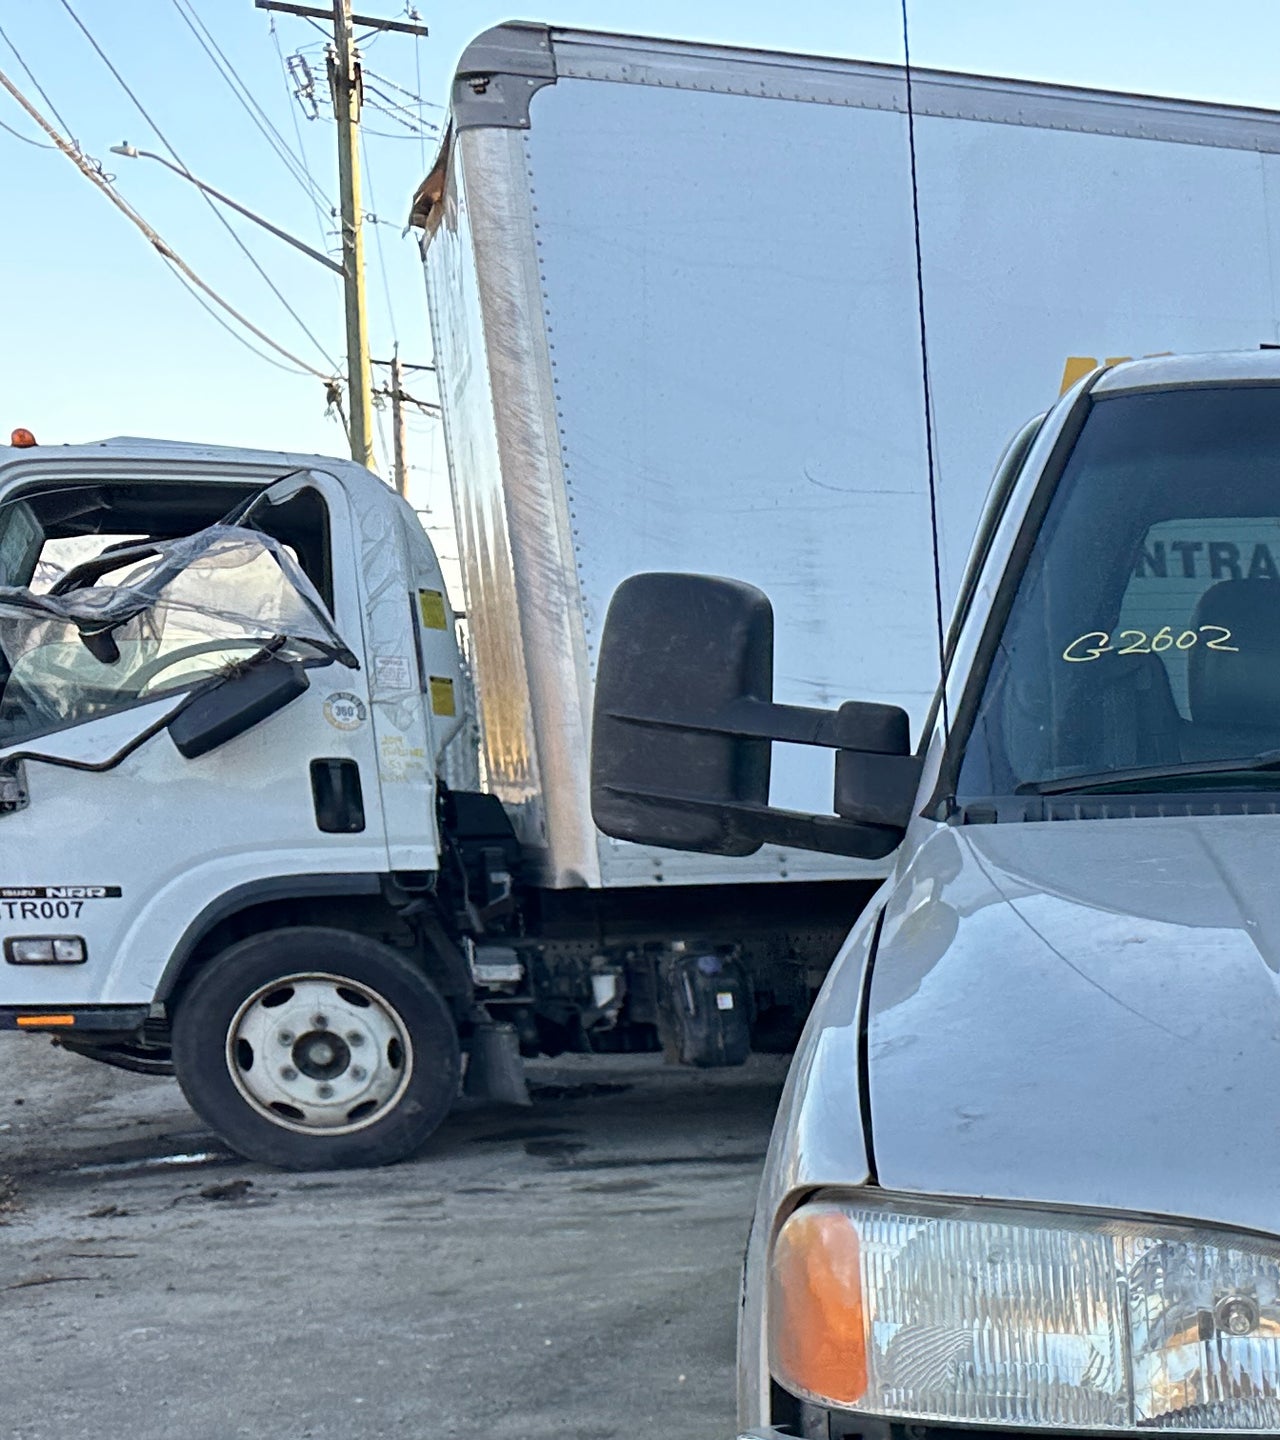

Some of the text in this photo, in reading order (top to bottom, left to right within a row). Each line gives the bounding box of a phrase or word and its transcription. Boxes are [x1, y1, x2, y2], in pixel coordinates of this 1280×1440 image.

[1062, 625, 1239, 662] G2602
[45, 887, 106, 898] NRR
[0, 901, 84, 919] TR007
